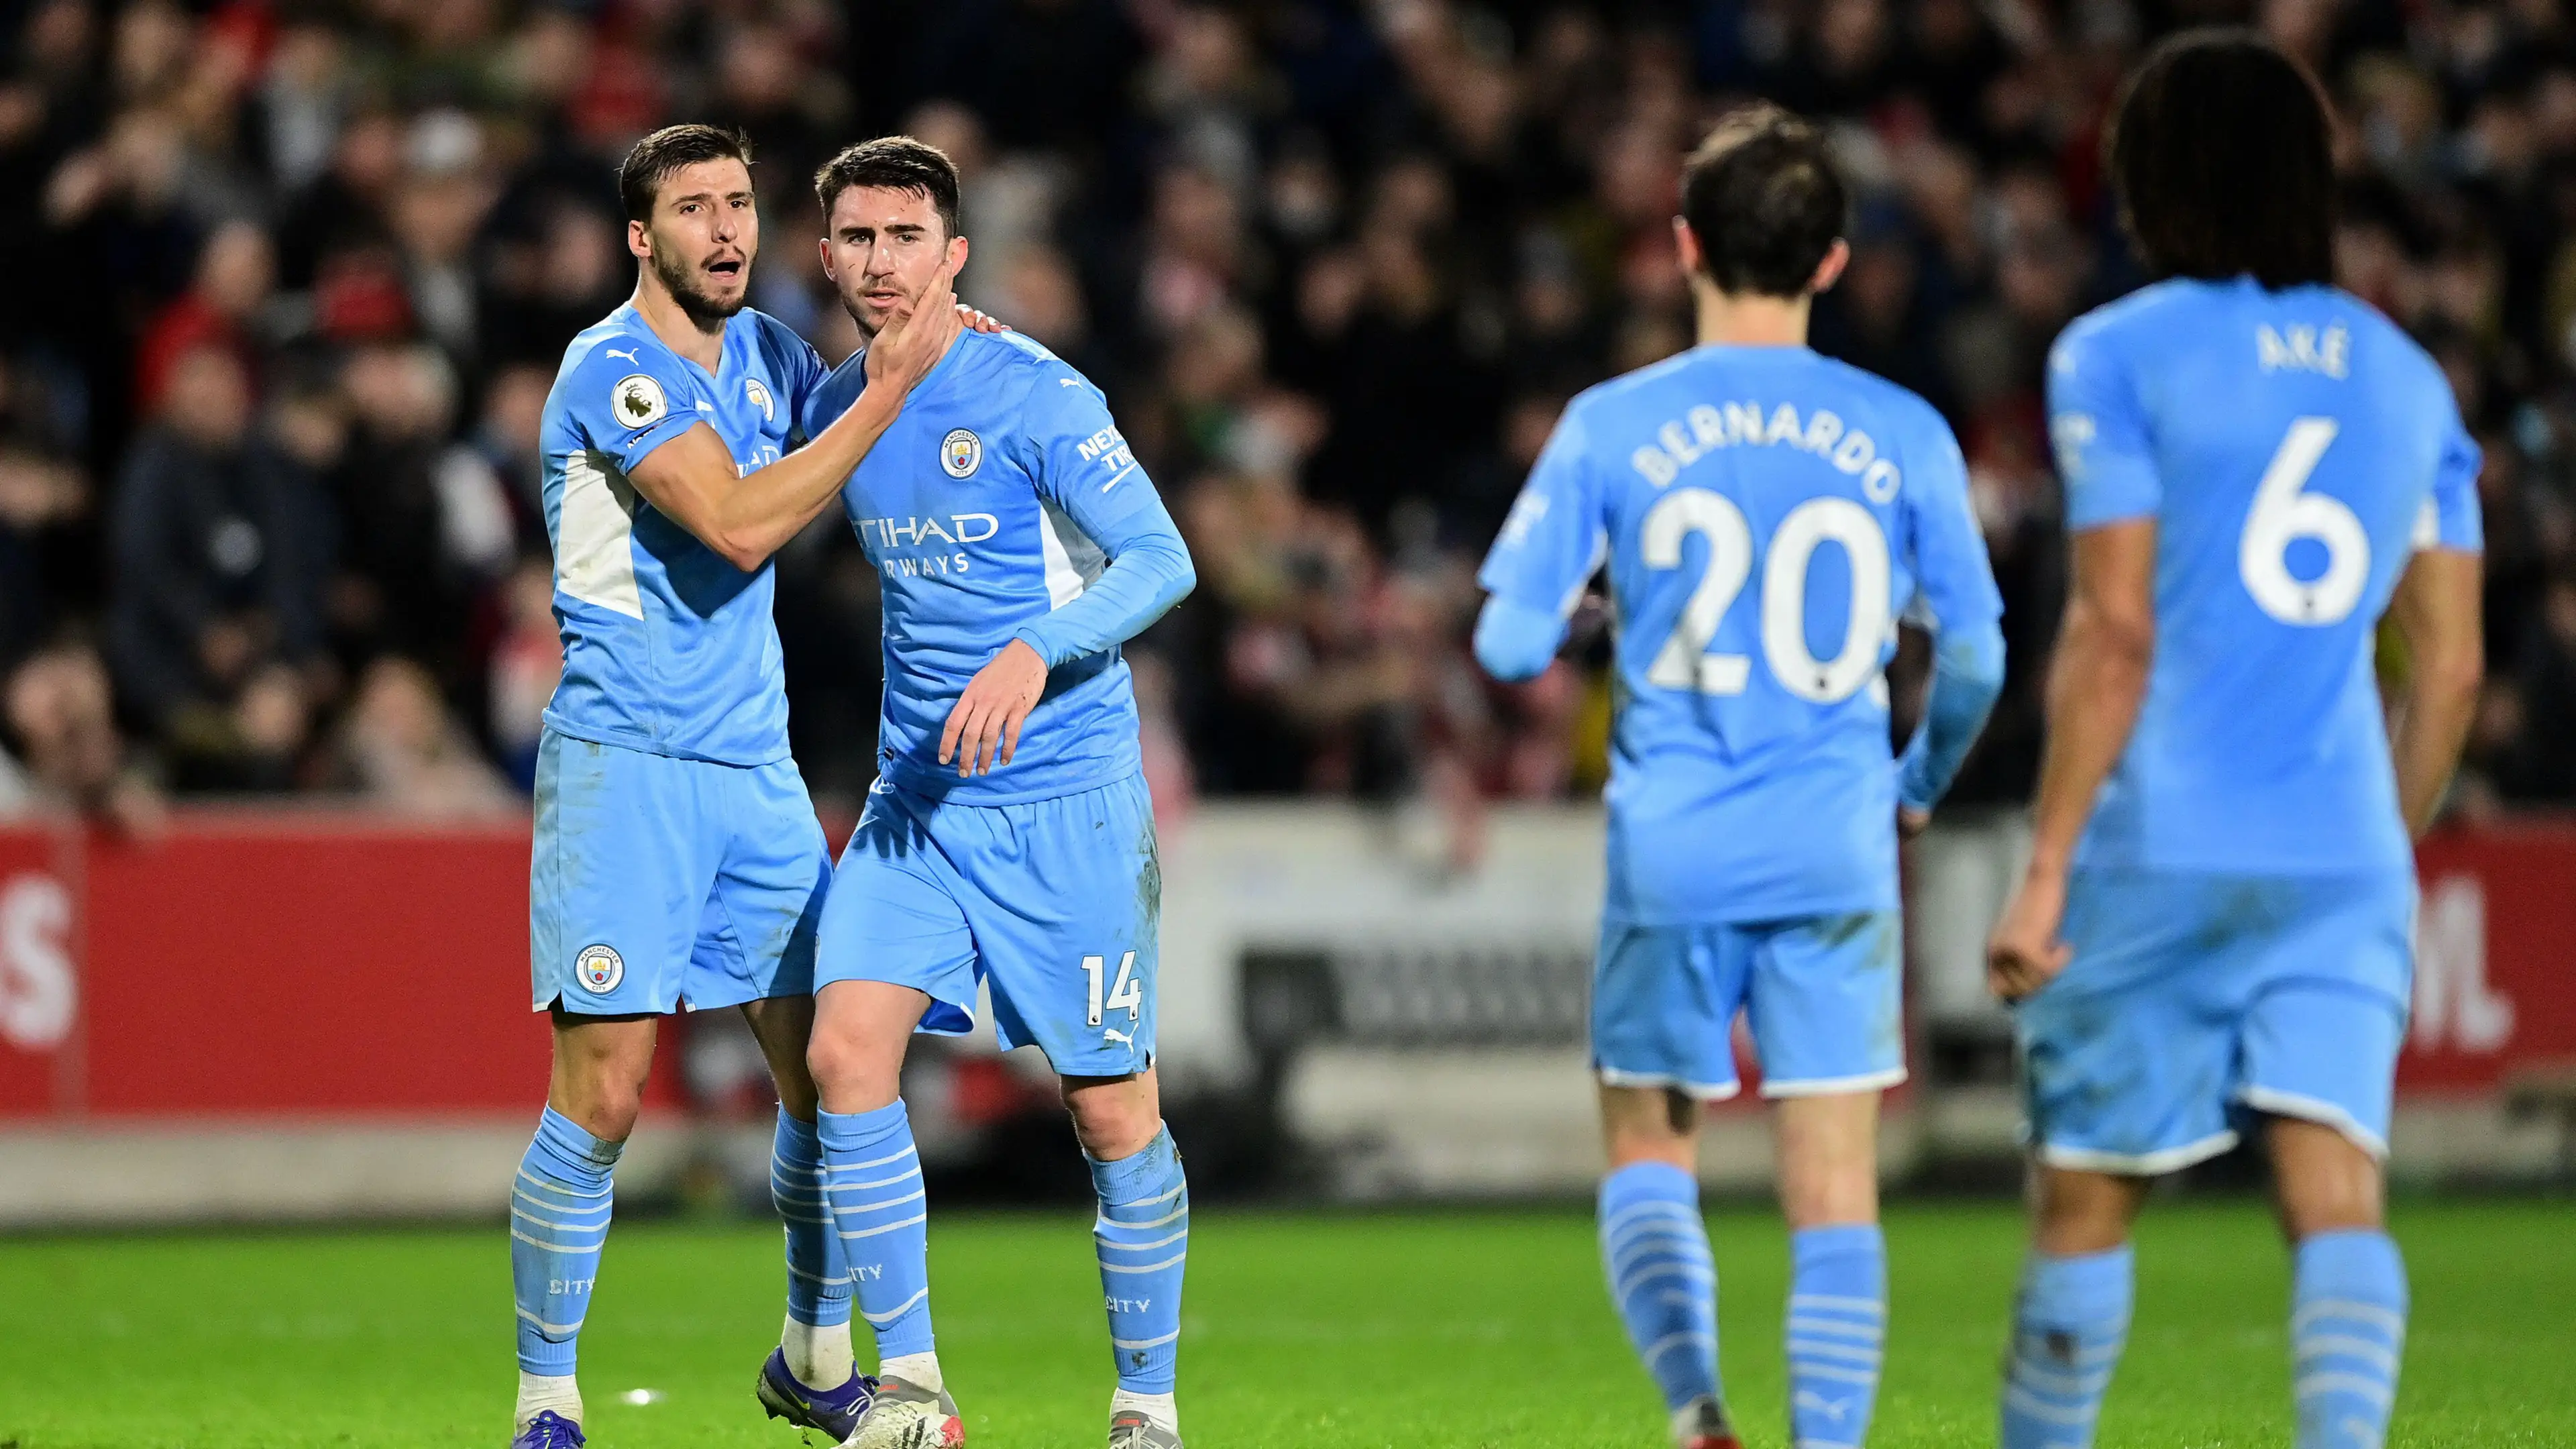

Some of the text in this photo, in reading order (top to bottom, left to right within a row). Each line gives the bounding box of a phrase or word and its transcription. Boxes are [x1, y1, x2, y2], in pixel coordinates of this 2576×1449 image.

[945, 431, 978, 449] MANCHESTER
[1631, 400, 1902, 504] BERNARDO
[851, 513, 999, 547] TIHAD
[2238, 415, 2372, 628] 6
[883, 552, 969, 578] RWAYS
[1641, 486, 1892, 704] 20
[580, 947, 620, 964] MANCHESTER
[1081, 950, 1142, 1026] 14
[549, 1276, 596, 1296] CITY
[846, 1264, 883, 1283] ITY
